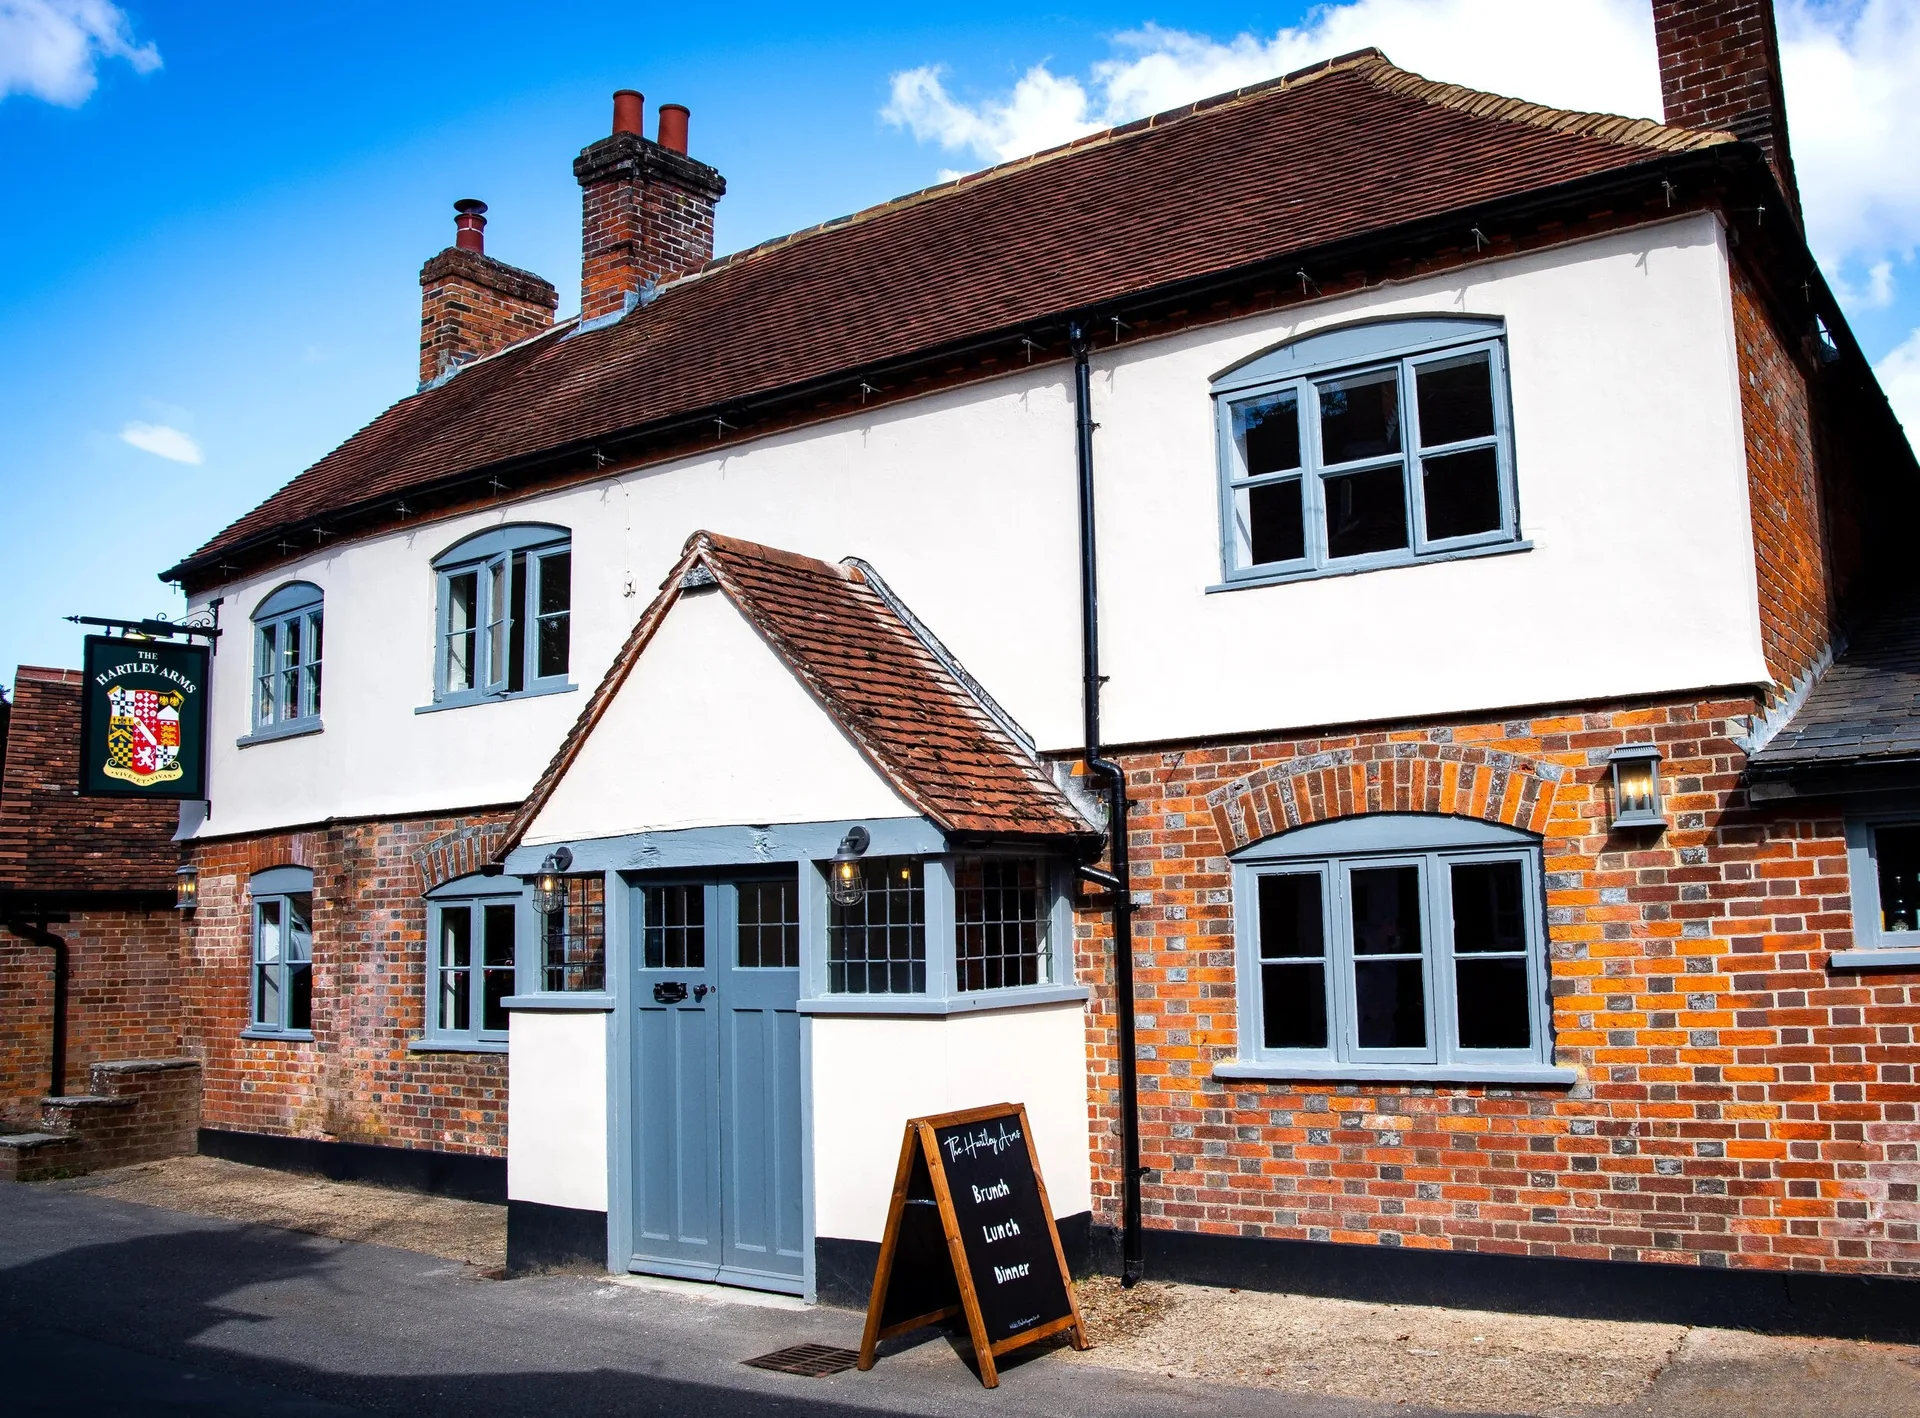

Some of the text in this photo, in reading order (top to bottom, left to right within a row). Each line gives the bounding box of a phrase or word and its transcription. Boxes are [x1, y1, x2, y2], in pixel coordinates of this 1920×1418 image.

[138, 651, 158, 660] THE
[95, 662, 197, 694] HARTLEY ARMS
[944, 1122, 1021, 1163] The Hartley Arms
[971, 1178, 1010, 1204] Brunch
[982, 1218, 1020, 1243] Lunch
[993, 1263, 1030, 1284] Dinner
